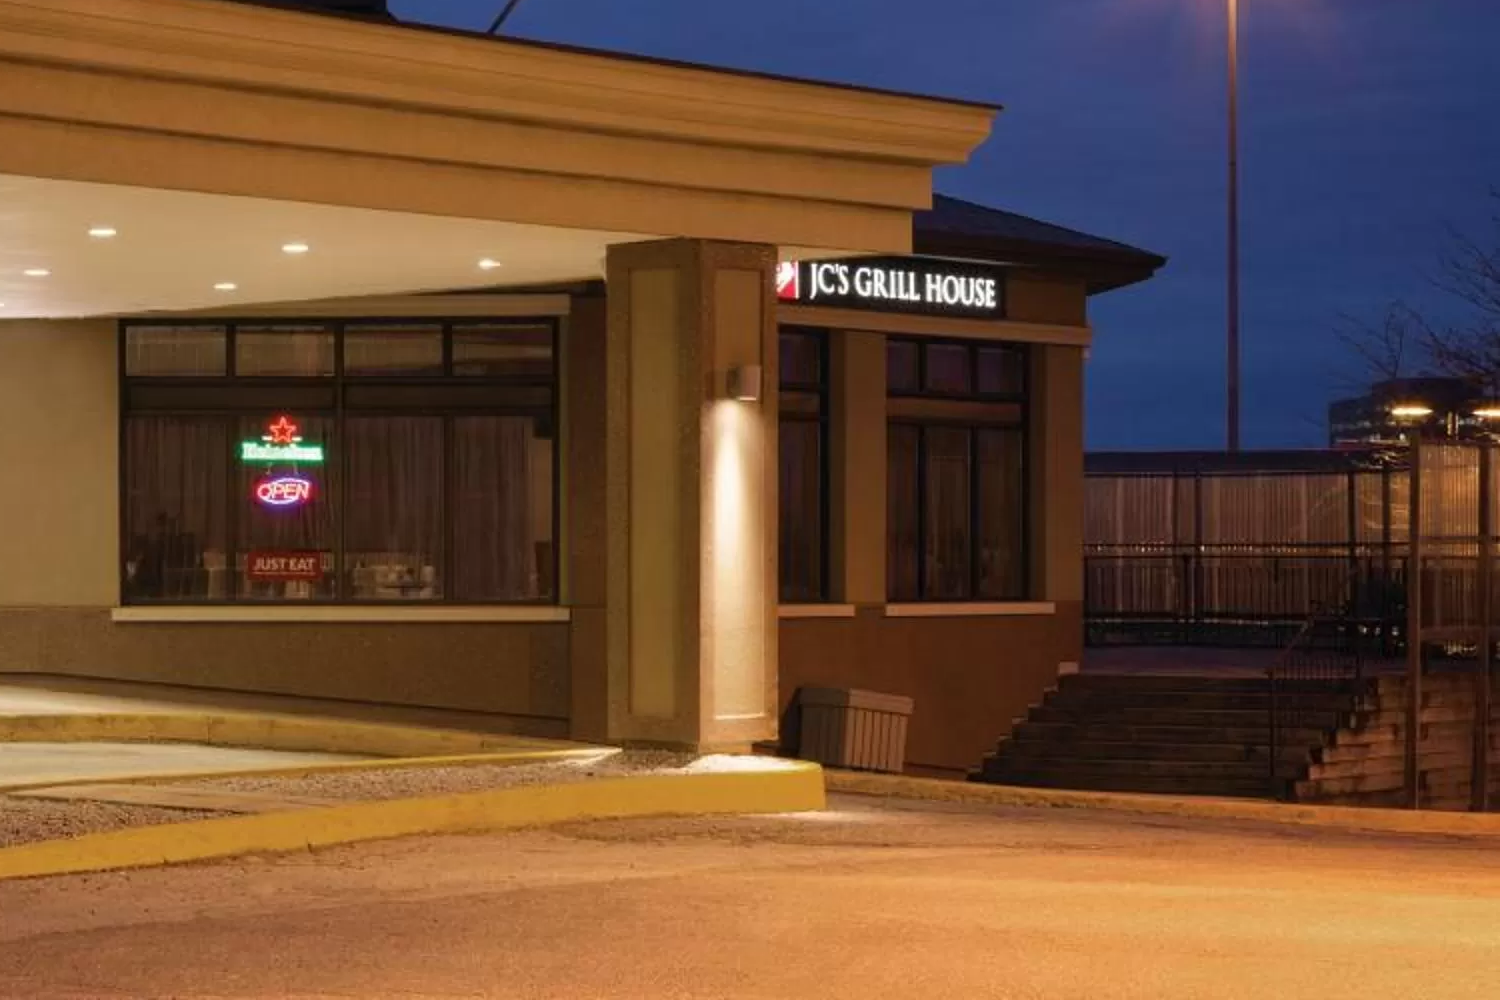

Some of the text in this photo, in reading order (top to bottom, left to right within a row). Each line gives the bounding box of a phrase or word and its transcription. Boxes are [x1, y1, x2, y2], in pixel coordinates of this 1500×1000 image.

[810, 263, 997, 308] JC'S GRILL HOUSE
[257, 482, 310, 500] OPEN
[253, 556, 316, 571] JUST EAT
